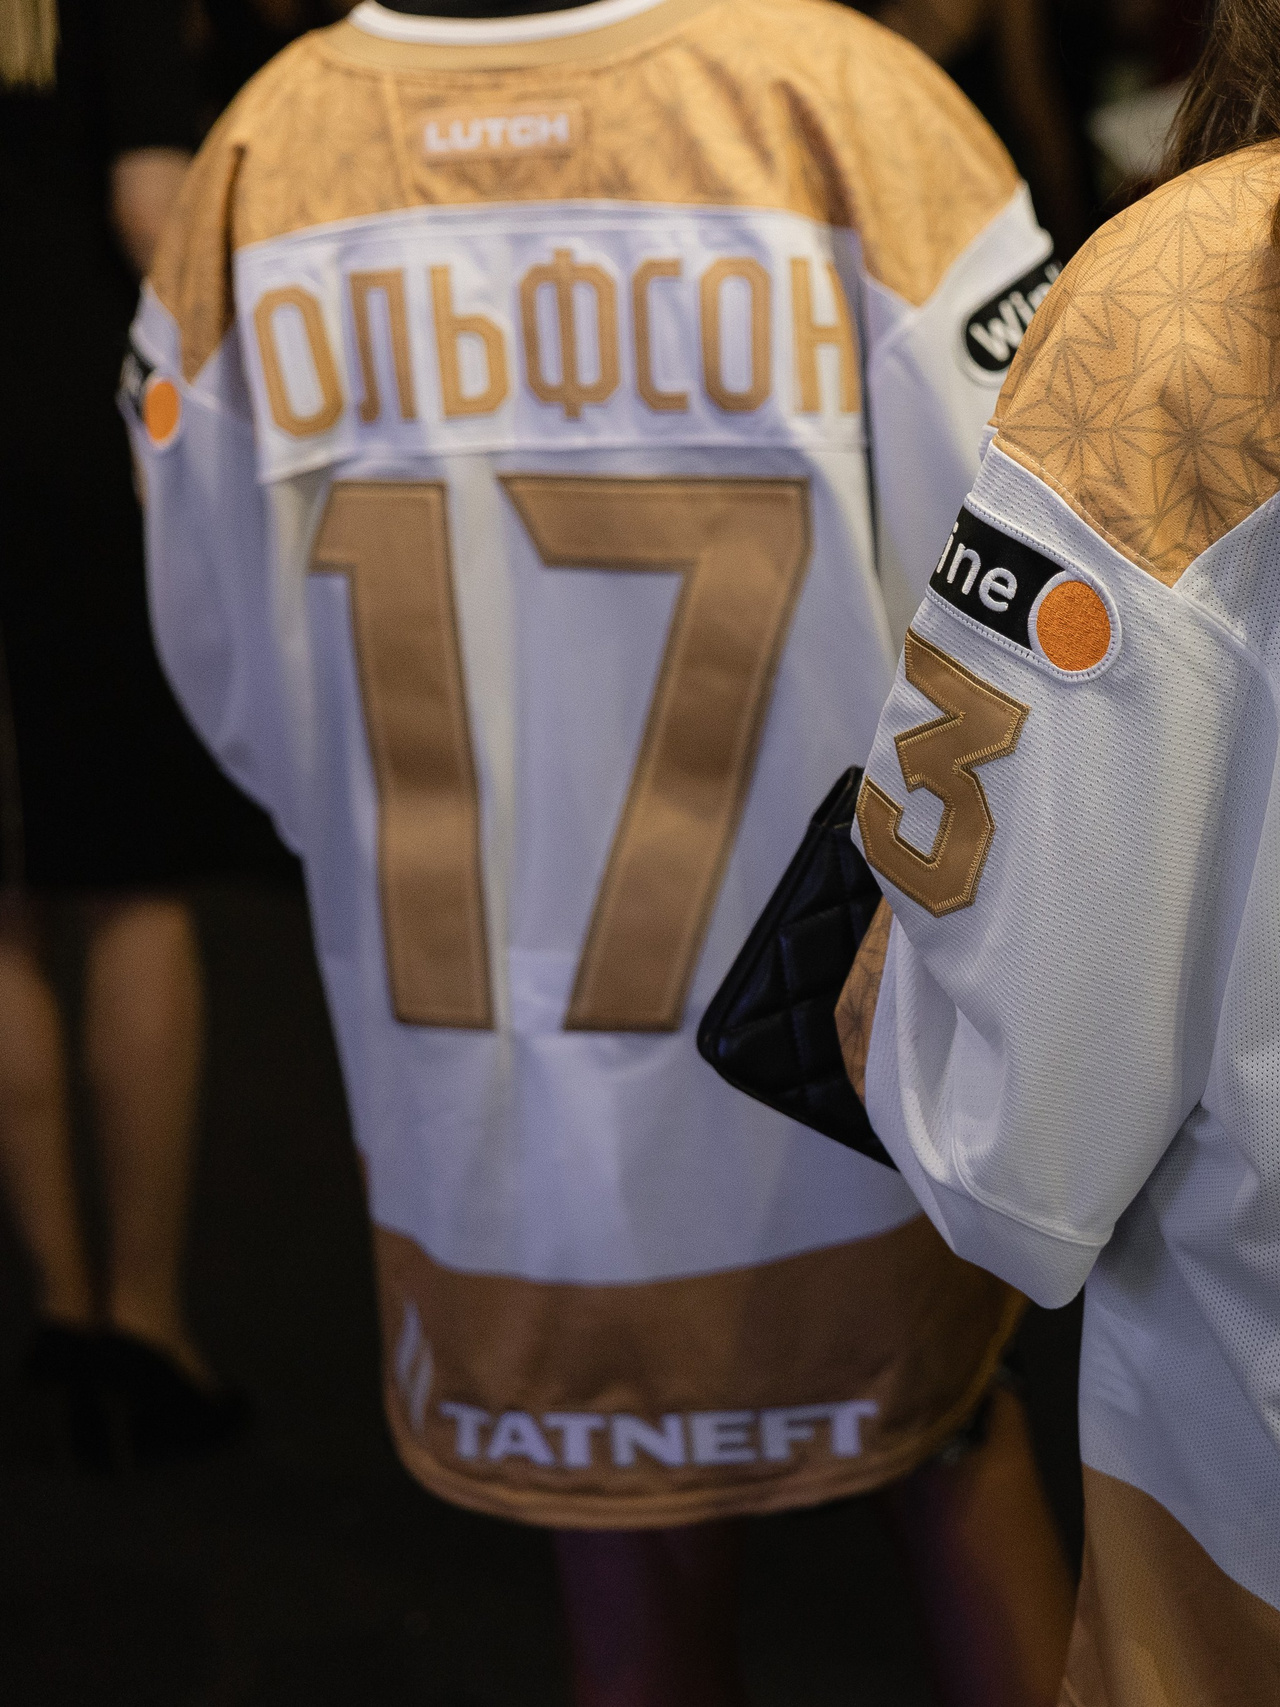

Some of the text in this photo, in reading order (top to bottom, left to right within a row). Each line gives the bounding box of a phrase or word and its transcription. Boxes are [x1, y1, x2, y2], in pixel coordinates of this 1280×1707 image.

[424, 112, 569, 153] LUTCH
[252, 247, 863, 438] ОЛЬФСОН
[305, 472, 814, 1033] 17
[856, 626, 1033, 918] 3
[437, 1400, 881, 1470] TATNEFT
